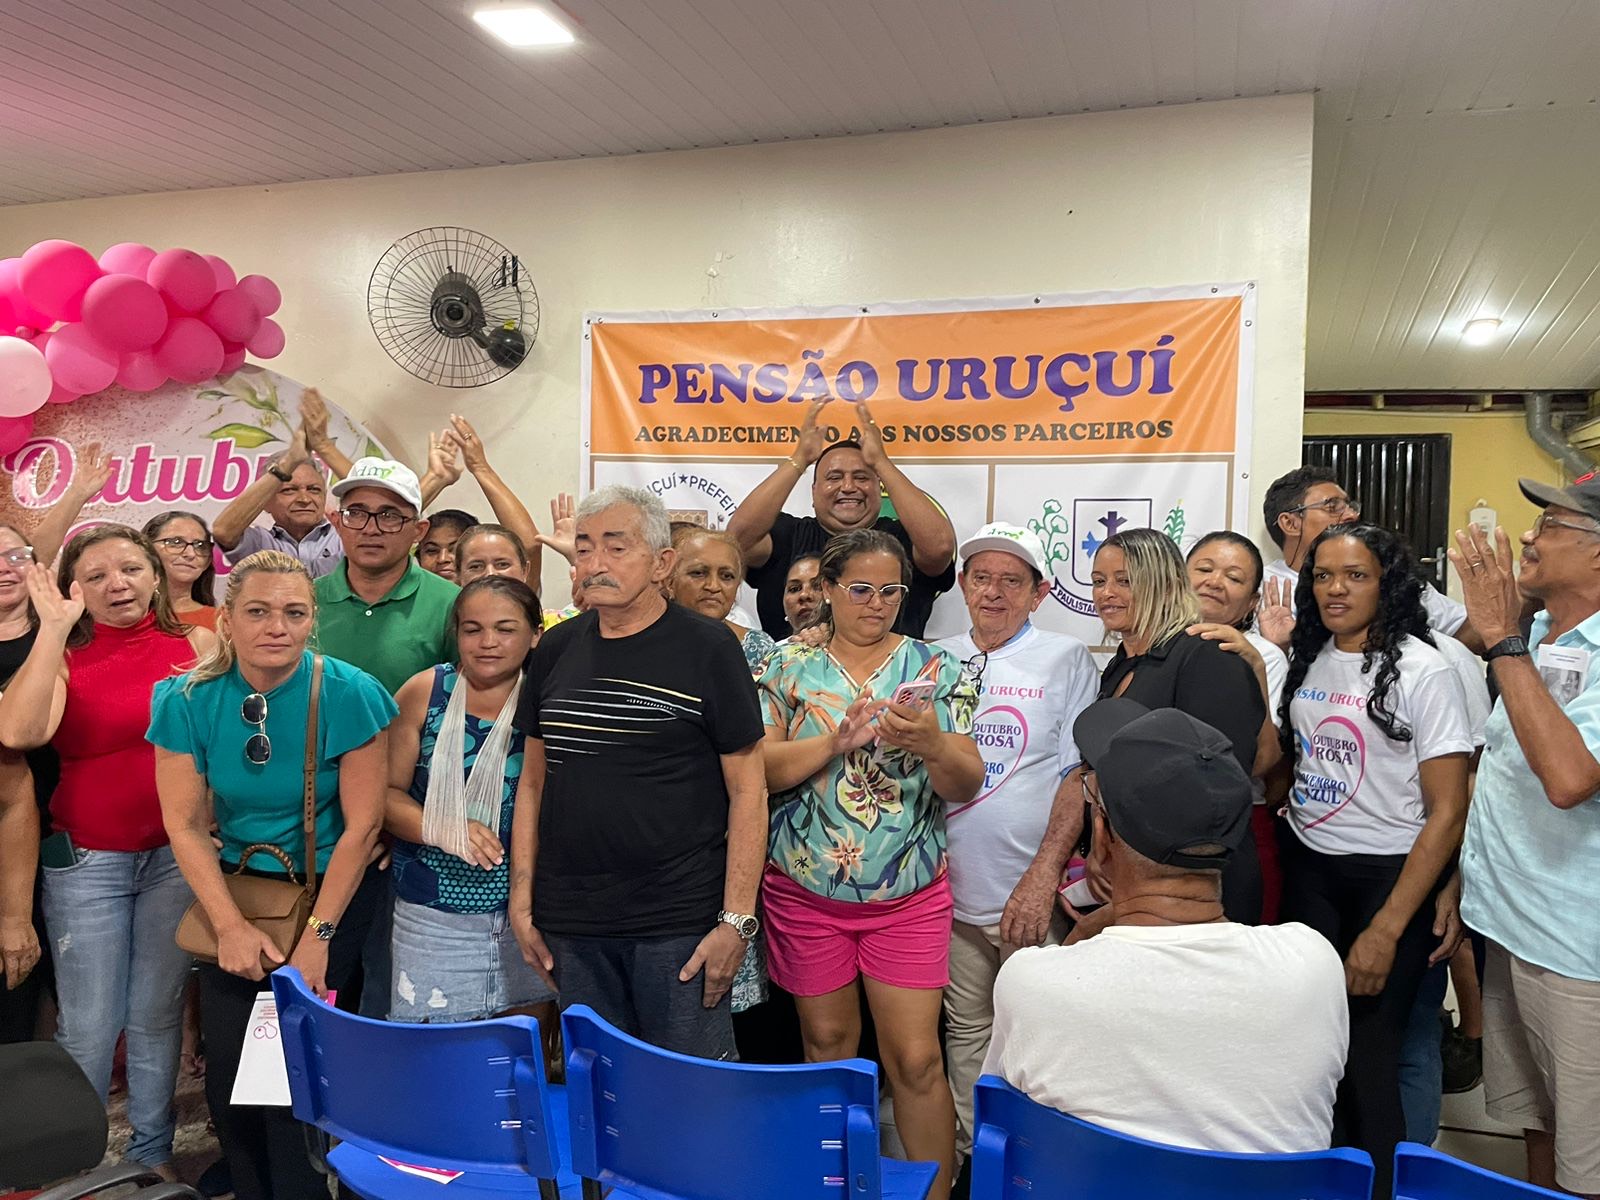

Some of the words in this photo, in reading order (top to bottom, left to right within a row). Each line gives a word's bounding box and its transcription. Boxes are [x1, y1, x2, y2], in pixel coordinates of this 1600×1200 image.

[638, 349, 879, 404] PENSÃO
[896, 334, 1176, 412] URUÇUÍ
[634, 425, 840, 443] AGRADECIMENO
[848, 425, 897, 443] AS
[903, 423, 1006, 443] NOSSOS
[1014, 420, 1173, 442] PARCEIROS
[647, 472, 677, 496] ÇUÍ
[1329, 692, 1366, 711] URUÇ
[974, 722, 1022, 736] OUTUBRO
[975, 734, 1015, 749] ROSA
[1313, 734, 1358, 753] OUTUBRO
[1315, 746, 1353, 766] ROSA
[1299, 772, 1347, 794] OVEMBRO
